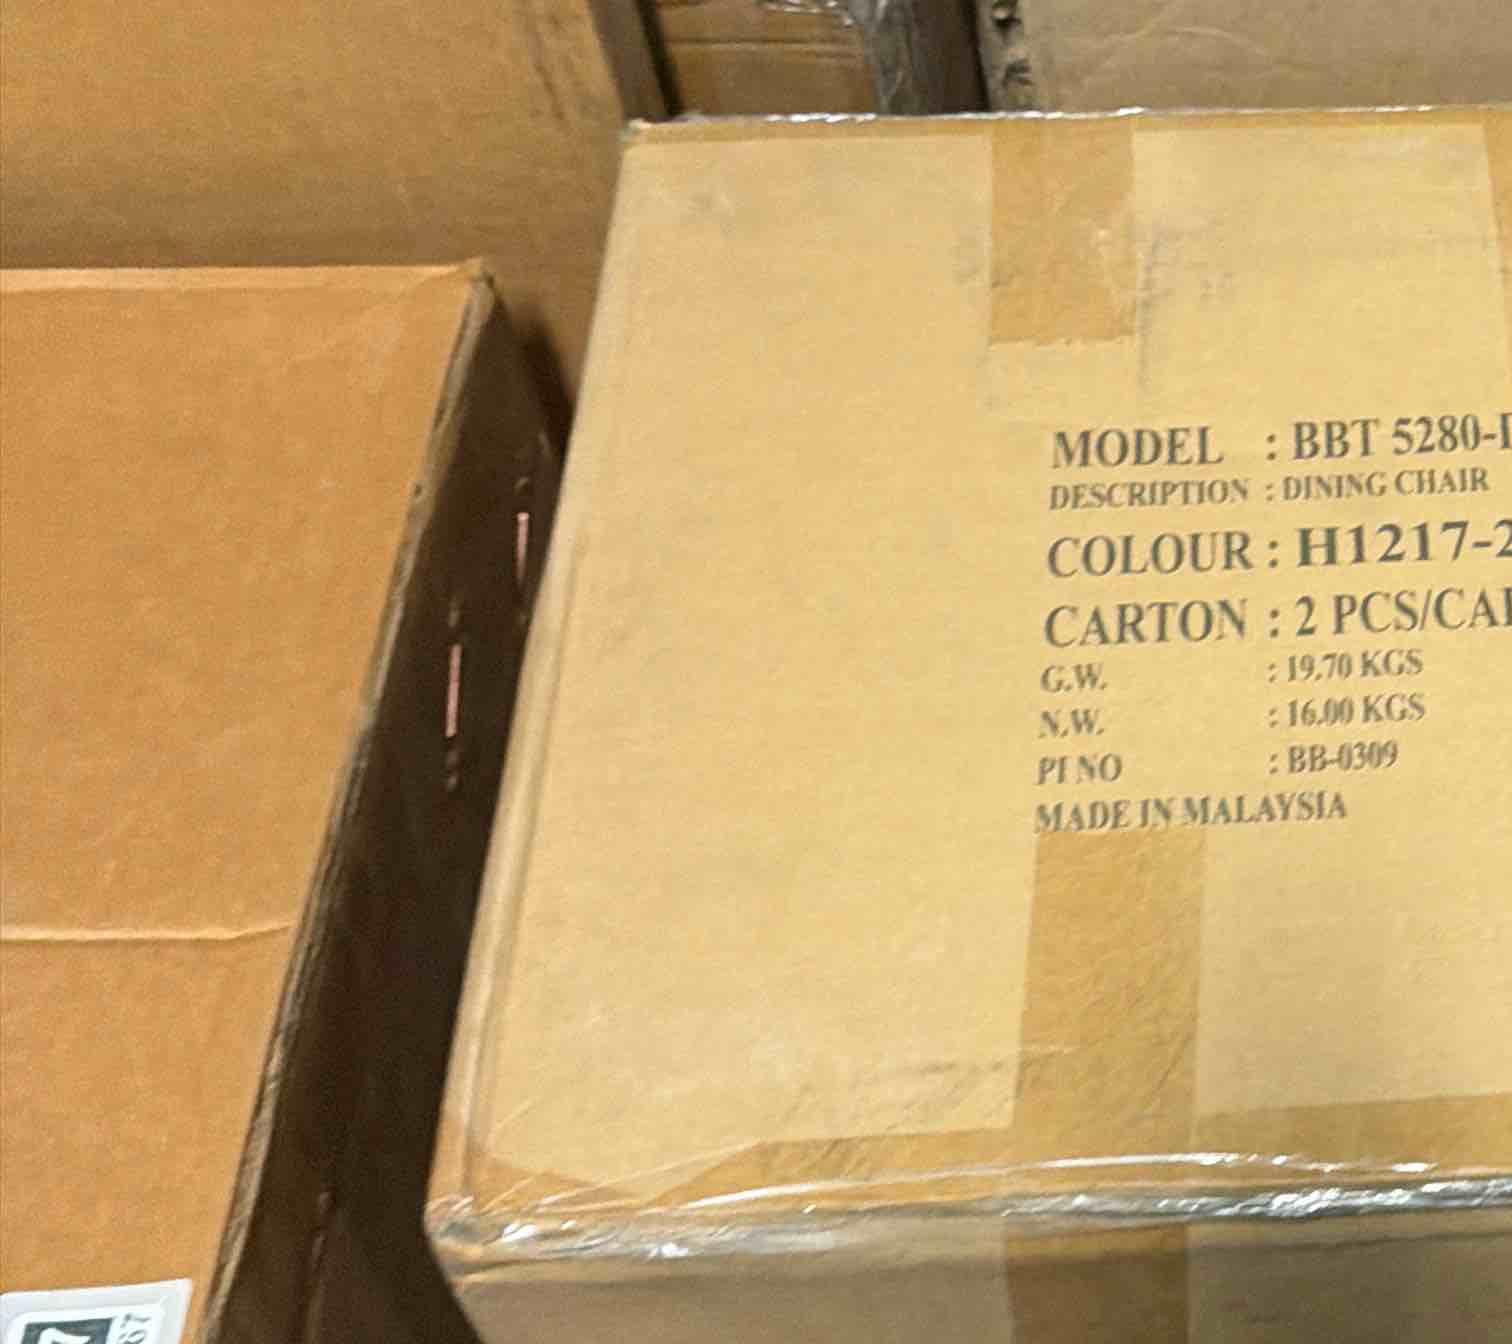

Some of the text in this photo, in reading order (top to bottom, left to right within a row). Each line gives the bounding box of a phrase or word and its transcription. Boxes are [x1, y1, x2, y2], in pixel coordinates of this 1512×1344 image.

[1051, 425, 1226, 469] MODEL
[1292, 418, 1380, 460] BBT
[1048, 478, 1251, 511] DESCRIPTION
[1281, 470, 1388, 502] DINING
[1393, 466, 1492, 496] CHAIR
[1046, 530, 1255, 579] COLOUR
[1043, 596, 1249, 649] CARTON
[1294, 594, 1318, 638] 2
[1040, 662, 1108, 694] G.W.
[1286, 653, 1354, 683] 19.70
[1360, 647, 1425, 678] KGS
[1361, 691, 1427, 724] KGS
[1076, 751, 1124, 785] NO
[1287, 739, 1399, 775] BB-0309
[1033, 787, 1349, 834] MADE IN MALAYSIA
